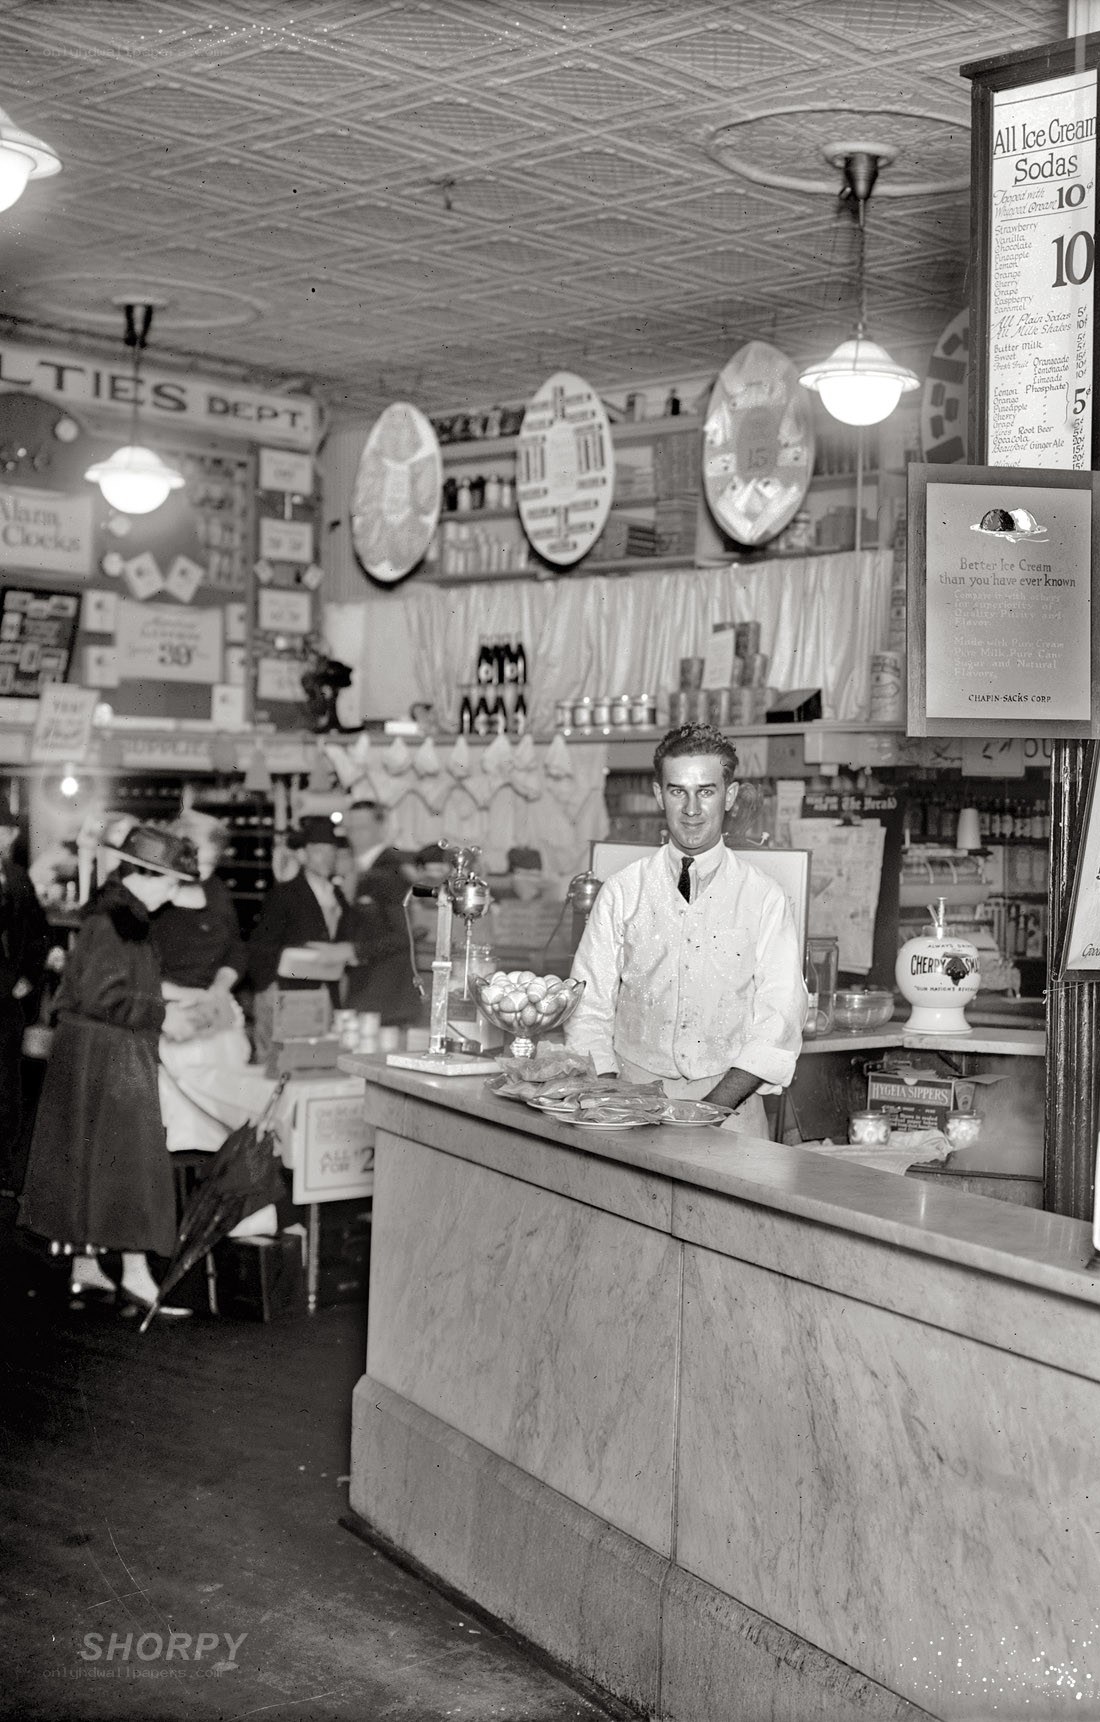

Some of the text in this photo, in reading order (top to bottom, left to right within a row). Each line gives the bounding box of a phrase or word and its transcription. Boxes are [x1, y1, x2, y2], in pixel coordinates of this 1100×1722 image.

[993, 116, 1097, 155] All Ice Cream
[1014, 154, 1078, 185] Sodas
[995, 222, 1039, 236] Strawberry
[995, 234, 1026, 245] Vanilla
[995, 242, 1032, 253] Chocolate
[995, 252, 1029, 263] Pineapple
[1051, 230, 1095, 288] 10
[994, 288, 1018, 297] Grape
[995, 296, 1033, 306] Raspberry
[995, 303, 1026, 314] Caramel
[991, 314, 1015, 329] All
[1017, 312, 1043, 327] Plain
[1044, 310, 1071, 323] Sodas
[1041, 323, 1071, 335] Shakes
[994, 340, 1043, 353] Butter Milk
[1033, 374, 1063, 384] Limeade
[994, 383, 1066, 397] Lemon Phosphate
[1018, 425, 1054, 435] Root Beer
[1030, 441, 1052, 452] Ginger
[1052, 438, 1065, 448] Ale
[959, 556, 1052, 572] Better Ice Cream
[939, 571, 1076, 588] than you have ever known
[974, 600, 1033, 610] superiority
[1016, 658, 1057, 669] Natural
[968, 693, 1029, 703] CHAPIN-SACKS
[910, 954, 947, 976] CHERRY
[872, 1082, 949, 1105] HYGEIA SIPPERS
